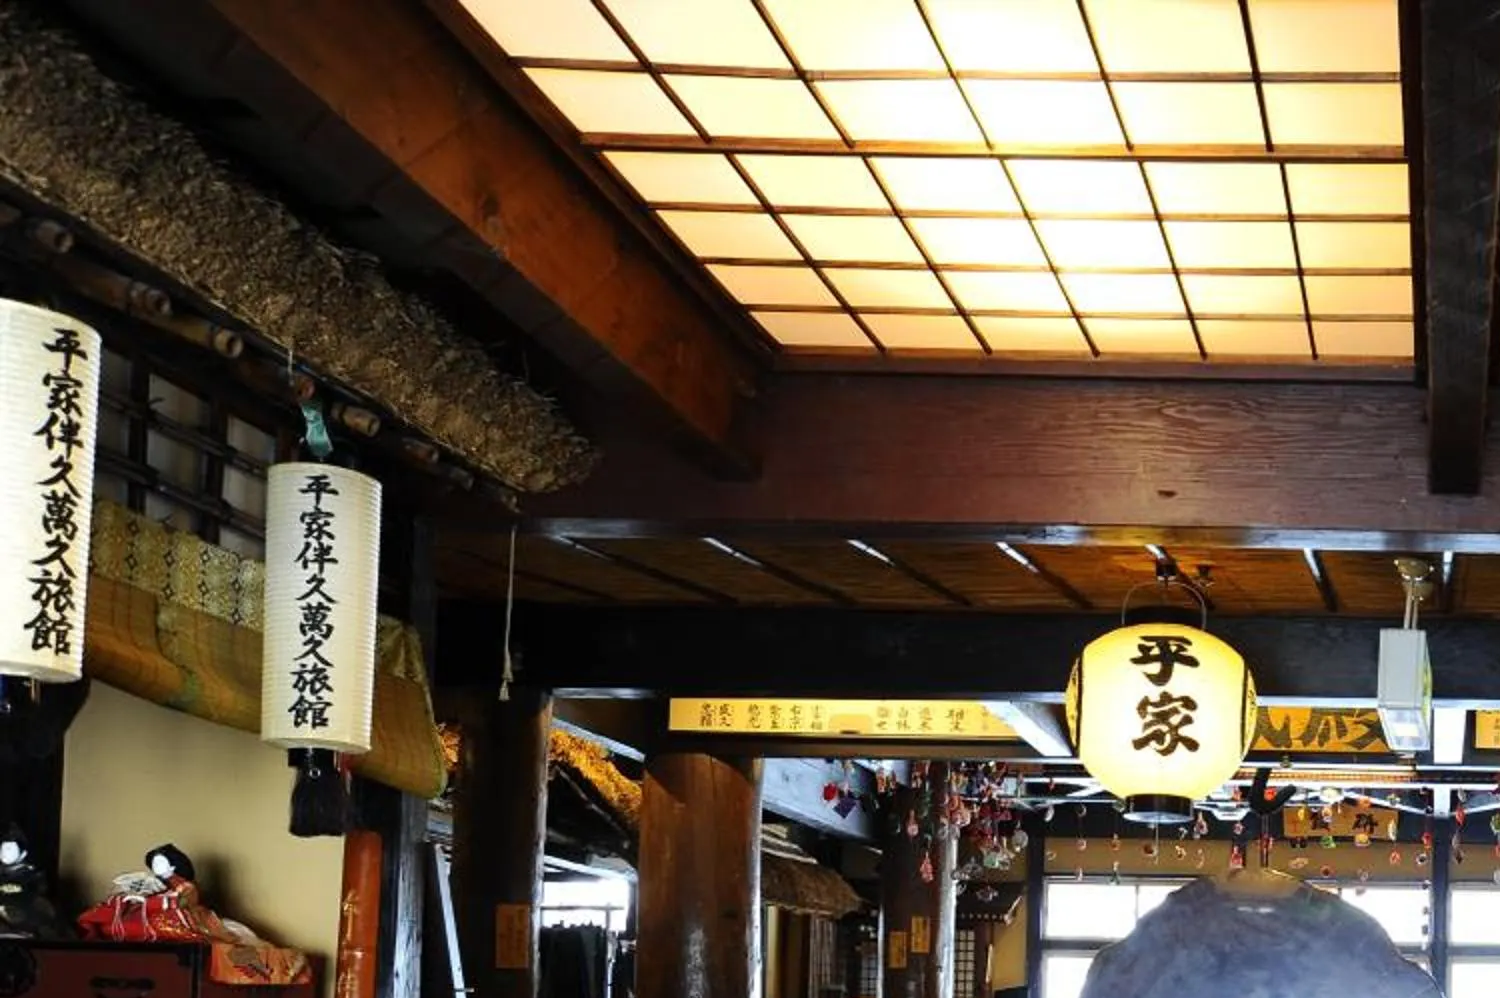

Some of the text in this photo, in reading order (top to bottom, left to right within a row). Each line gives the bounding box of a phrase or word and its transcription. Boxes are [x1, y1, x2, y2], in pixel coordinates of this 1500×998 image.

[24, 327, 88, 656] 平家伴久萬久旅館
[287, 474, 340, 731] 平家伴久萬久旅館
[1129, 635, 1200, 757] 平家
